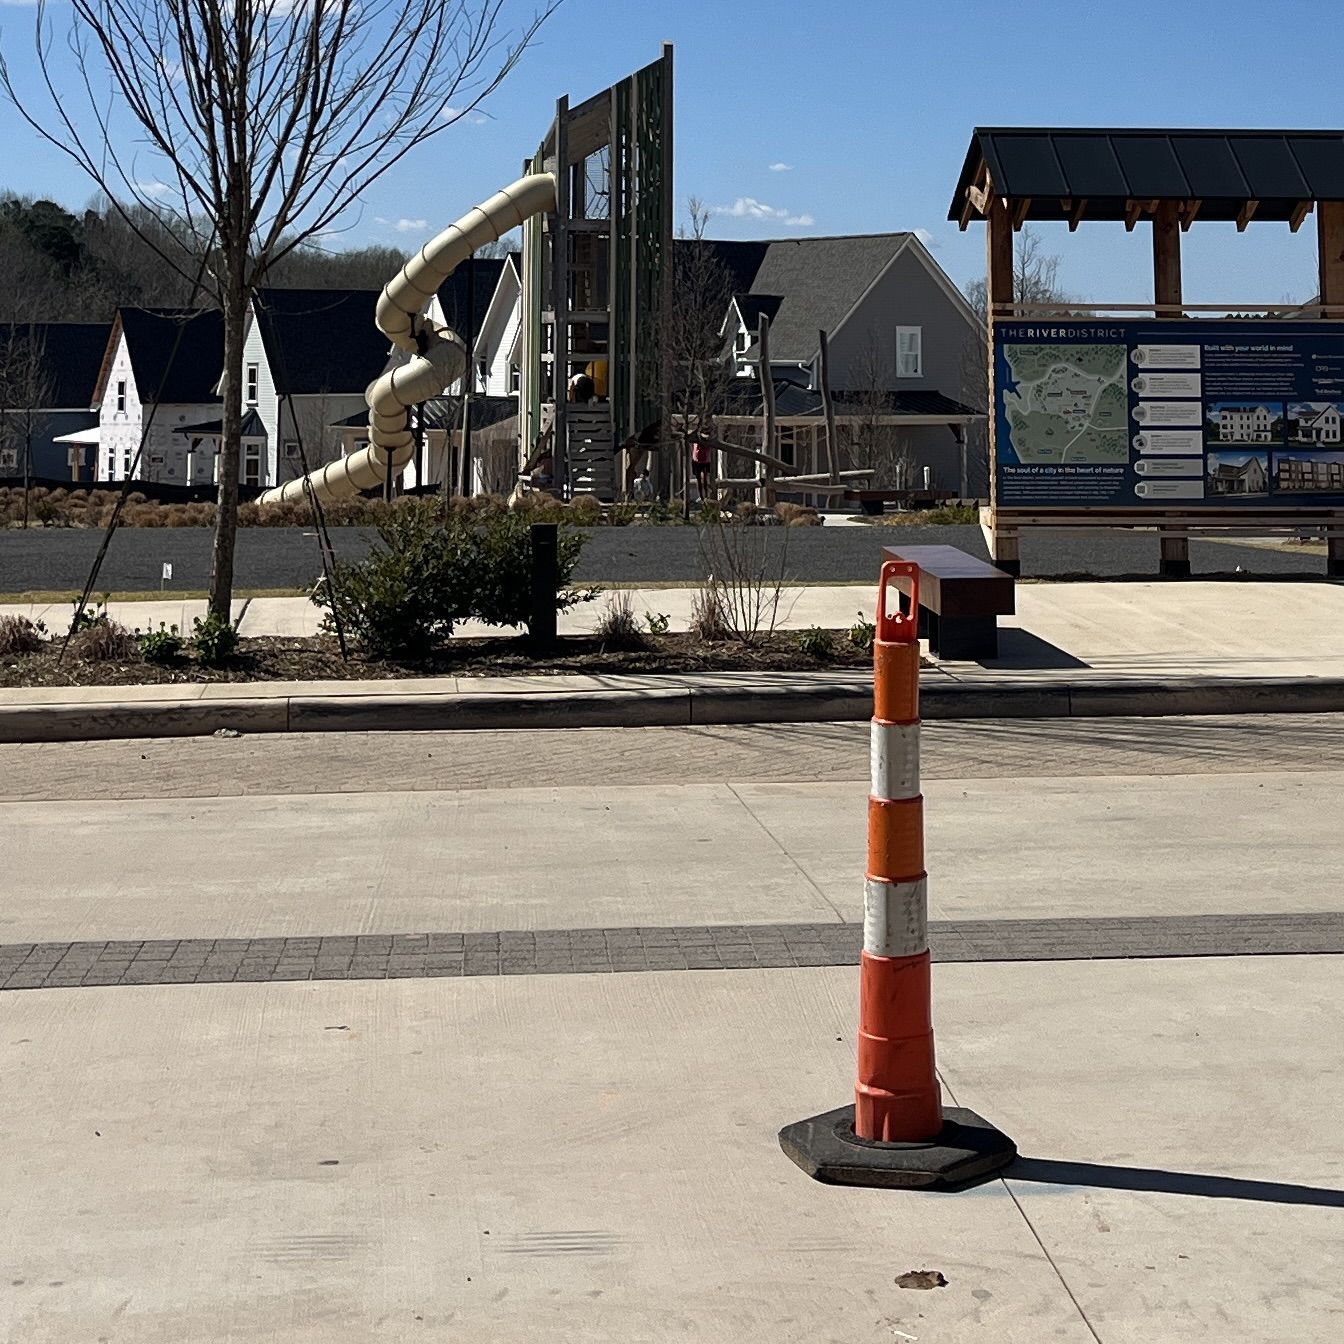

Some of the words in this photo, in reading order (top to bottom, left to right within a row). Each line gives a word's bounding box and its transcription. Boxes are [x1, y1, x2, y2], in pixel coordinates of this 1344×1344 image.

[1235, 345, 1249, 353] your
[1003, 466, 1016, 474] The
[1016, 466, 1031, 474] soul
[1044, 467, 1056, 475] city
[1064, 466, 1076, 474] the
[1076, 466, 1094, 474] heart
[1102, 467, 1124, 475] nature
